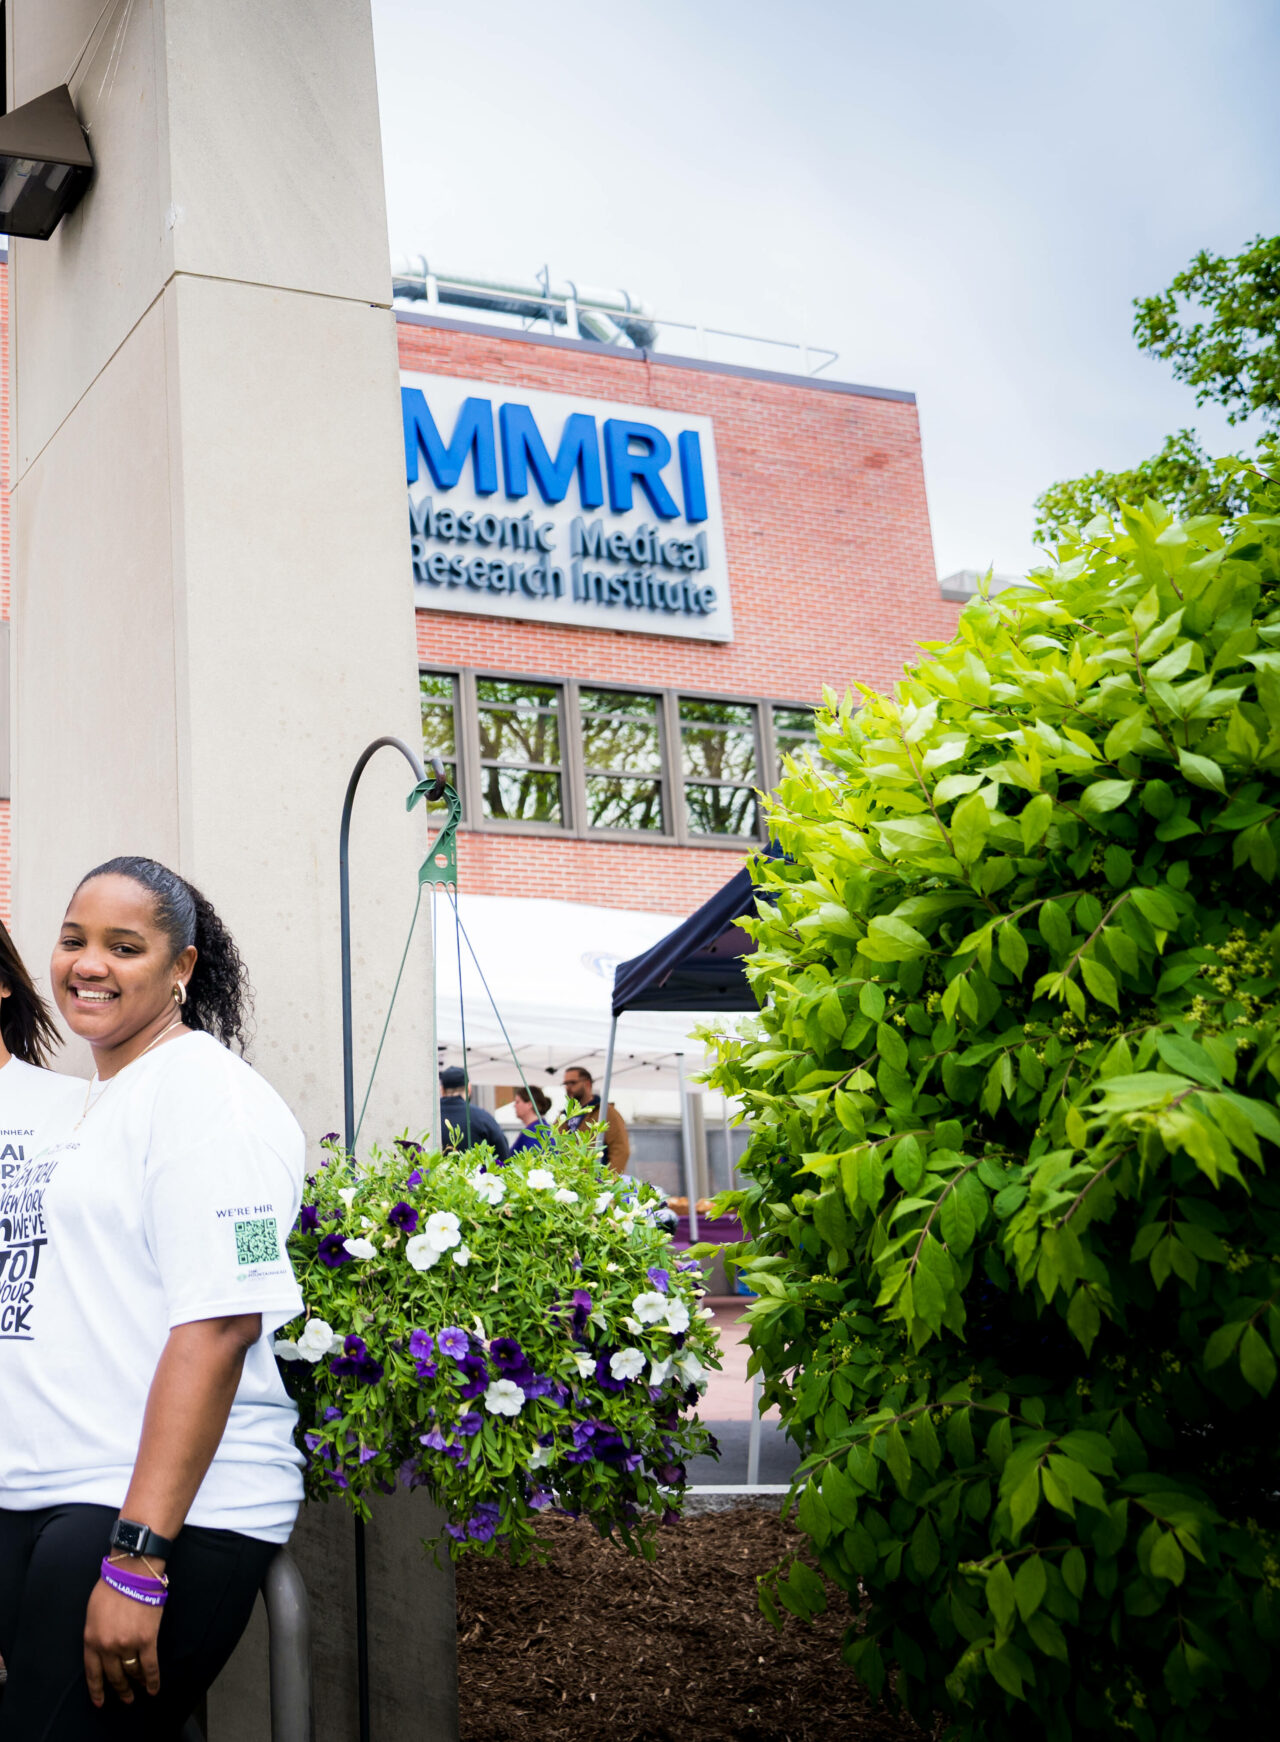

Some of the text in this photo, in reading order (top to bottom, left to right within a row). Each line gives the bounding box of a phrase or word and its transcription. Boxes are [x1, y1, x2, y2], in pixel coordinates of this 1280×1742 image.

[400, 387, 708, 524] MMRI
[408, 494, 709, 572] Masonic Medical
[411, 538, 717, 614] Research Institute
[12, 1212, 47, 1241] WE'VE
[215, 1203, 274, 1219] WE'RE HIR
